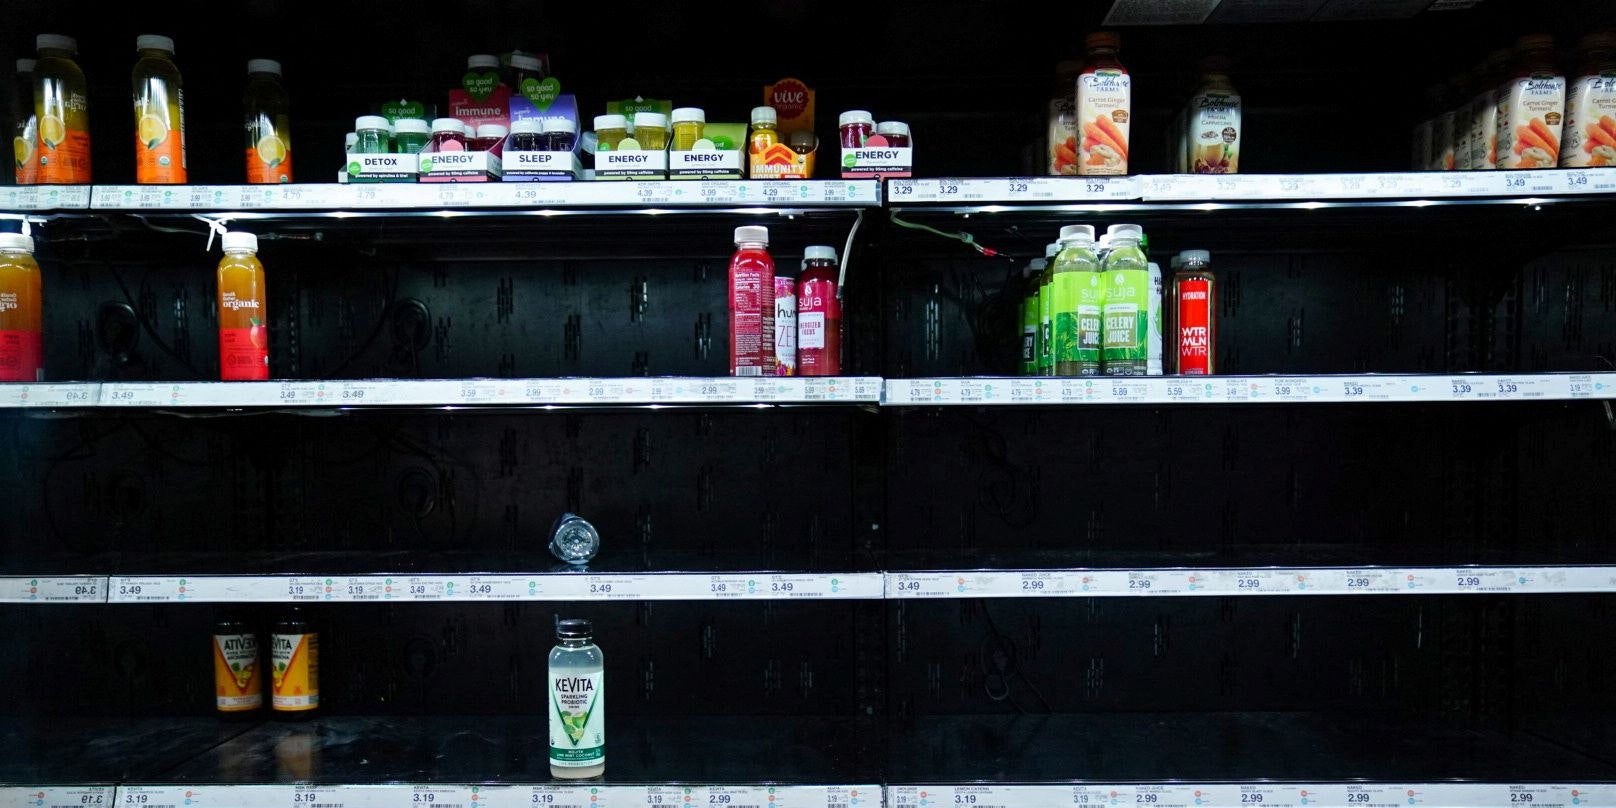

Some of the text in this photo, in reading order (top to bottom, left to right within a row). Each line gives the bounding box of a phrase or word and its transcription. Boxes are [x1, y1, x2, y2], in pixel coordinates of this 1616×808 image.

[774, 90, 804, 104] vive
[432, 155, 474, 164] ENERGY
[519, 154, 552, 163] SLEEP
[608, 155, 648, 164] ENERGY
[685, 154, 724, 163] ENERGY
[856, 151, 900, 160] ENERGY
[365, 158, 398, 166] DETOX
[752, 163, 805, 174] IMMUNITY
[1506, 178, 1525, 188] 3.49
[1567, 176, 1587, 186] 3.49
[701, 188, 716, 197] 3.99
[763, 188, 778, 197] 4.29
[894, 186, 912, 195] 3.29
[939, 185, 958, 194] 3.29
[1009, 184, 1028, 193] 3.29
[1086, 184, 1105, 193] 3.29
[515, 190, 536, 199] 4.39
[638, 189, 653, 198] 4.39
[1106, 286, 1136, 301] suja
[222, 299, 260, 311] organic
[798, 296, 822, 310] suja
[1106, 316, 1135, 330] CELERY
[1181, 326, 1207, 336] WTR
[1108, 330, 1131, 343] JUICE
[1181, 336, 1207, 346] MLN
[1181, 346, 1207, 356] WTR
[526, 388, 541, 397] 2.99
[588, 387, 604, 396] 2.99
[702, 386, 717, 395] 2.99
[1112, 387, 1128, 396] 5.89
[1167, 387, 1183, 396] 5.59
[1274, 386, 1290, 395] 3.99
[1344, 386, 1363, 395] 3.39
[1452, 384, 1471, 393] 3.39
[1498, 384, 1517, 393] 3.39
[111, 391, 134, 400] 3.49
[280, 391, 296, 400] 3.49
[342, 390, 365, 399] 3.49
[460, 389, 476, 398] 3.59
[898, 581, 920, 591] 3.49
[1022, 580, 1044, 589] 2.99
[1129, 579, 1151, 589] 2.99
[1237, 579, 1259, 588] 2.99
[1347, 578, 1369, 587] 2.99
[1457, 577, 1479, 586] 2.99
[119, 586, 141, 595] 3.49
[289, 586, 304, 595] 3.19
[348, 585, 363, 595] 3.19
[410, 585, 425, 594] 3.49
[470, 584, 491, 593] 3.49
[590, 584, 612, 593] 3.49
[711, 583, 726, 592] 3.49
[771, 582, 792, 591] 3.49
[555, 677, 594, 693] KEVITA
[126, 794, 148, 804] 3.19
[294, 793, 316, 802] 3.19
[413, 793, 435, 802] 3.19
[532, 794, 554, 803] 3.19
[647, 795, 663, 804] 3.19
[709, 794, 731, 804] 2.99
[954, 794, 976, 804] 3.19
[1073, 794, 1089, 804] 3.19
[1136, 794, 1157, 803] 2.99
[1241, 793, 1263, 803] 2.99
[1348, 793, 1369, 803] 2.99
[1510, 793, 1532, 803] 2.99
